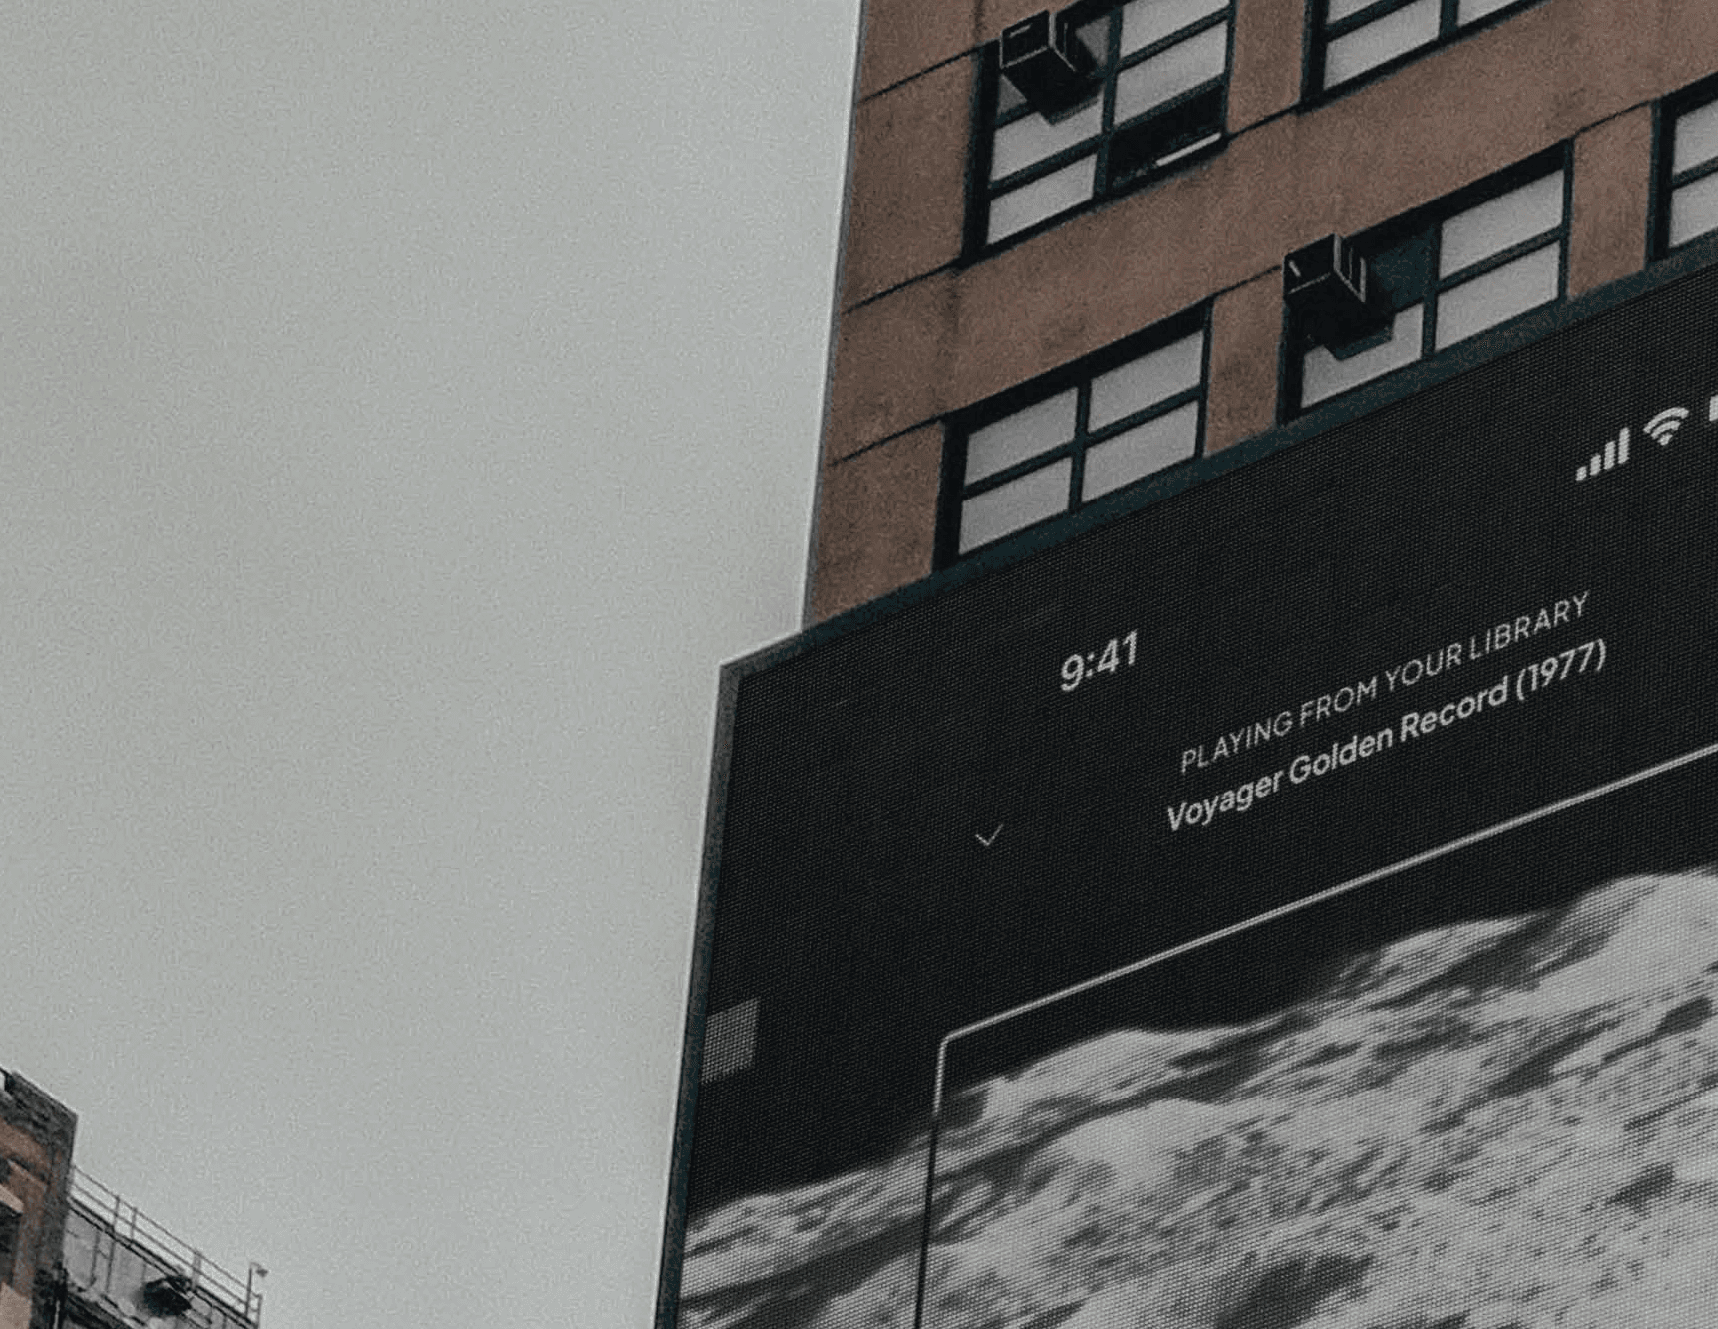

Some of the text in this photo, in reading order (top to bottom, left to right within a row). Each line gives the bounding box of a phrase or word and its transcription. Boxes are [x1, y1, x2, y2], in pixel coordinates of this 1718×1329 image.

[1058, 629, 1140, 693] 9:41
[1166, 638, 1608, 833] Voyager Golden Record (1977)
[1179, 590, 1592, 775] PLAYING FROM YOUR LIBRARY
